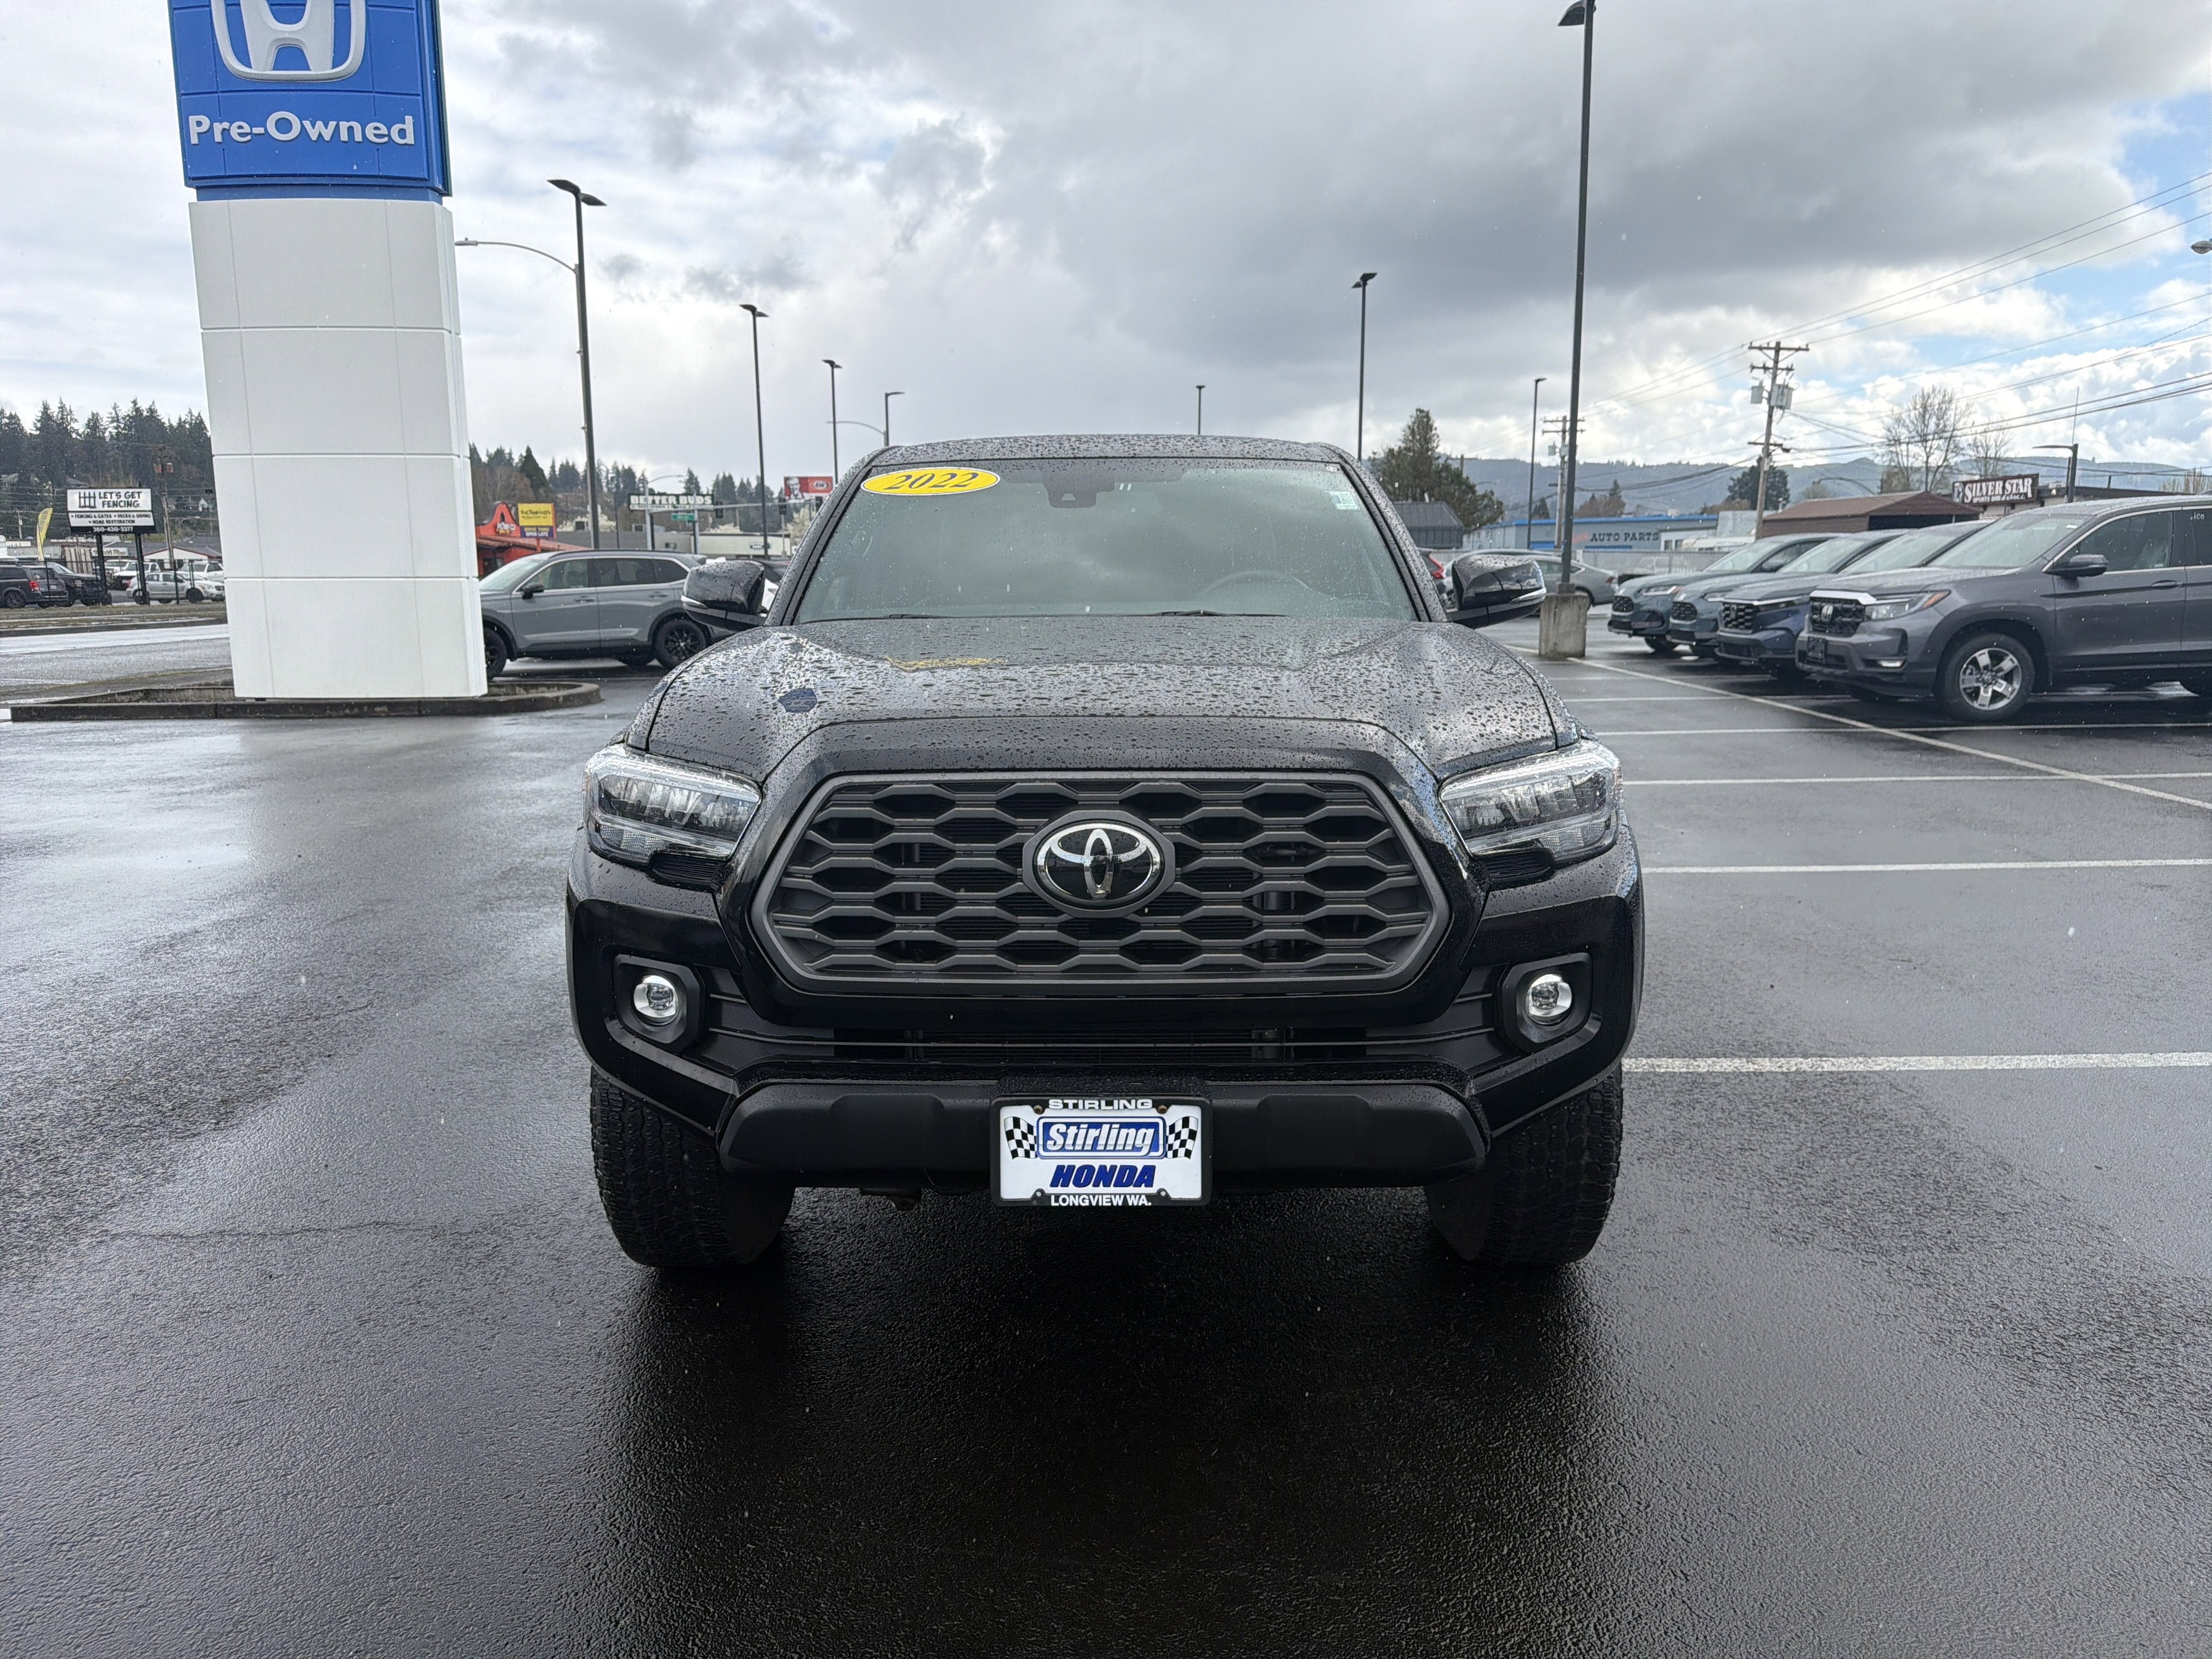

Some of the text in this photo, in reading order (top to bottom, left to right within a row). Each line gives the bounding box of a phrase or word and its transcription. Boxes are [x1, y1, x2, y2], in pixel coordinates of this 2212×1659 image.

[188, 111, 415, 145] Pre-Owned
[883, 472, 979, 490] 2022
[98, 490, 142, 499] LET'S GET
[1964, 477, 2033, 503] SILVER STAR
[101, 500, 140, 508] FENCING
[630, 495, 713, 505] BETTER BUDS
[1590, 532, 1620, 542] AUTO
[1623, 532, 1660, 541] PARTS
[1048, 1099, 1152, 1110] STIRLING
[1046, 1123, 1155, 1156] Stirling
[1049, 1164, 1156, 1188] HONDA
[1051, 1194, 1152, 1206] LONGVIEW WA.
